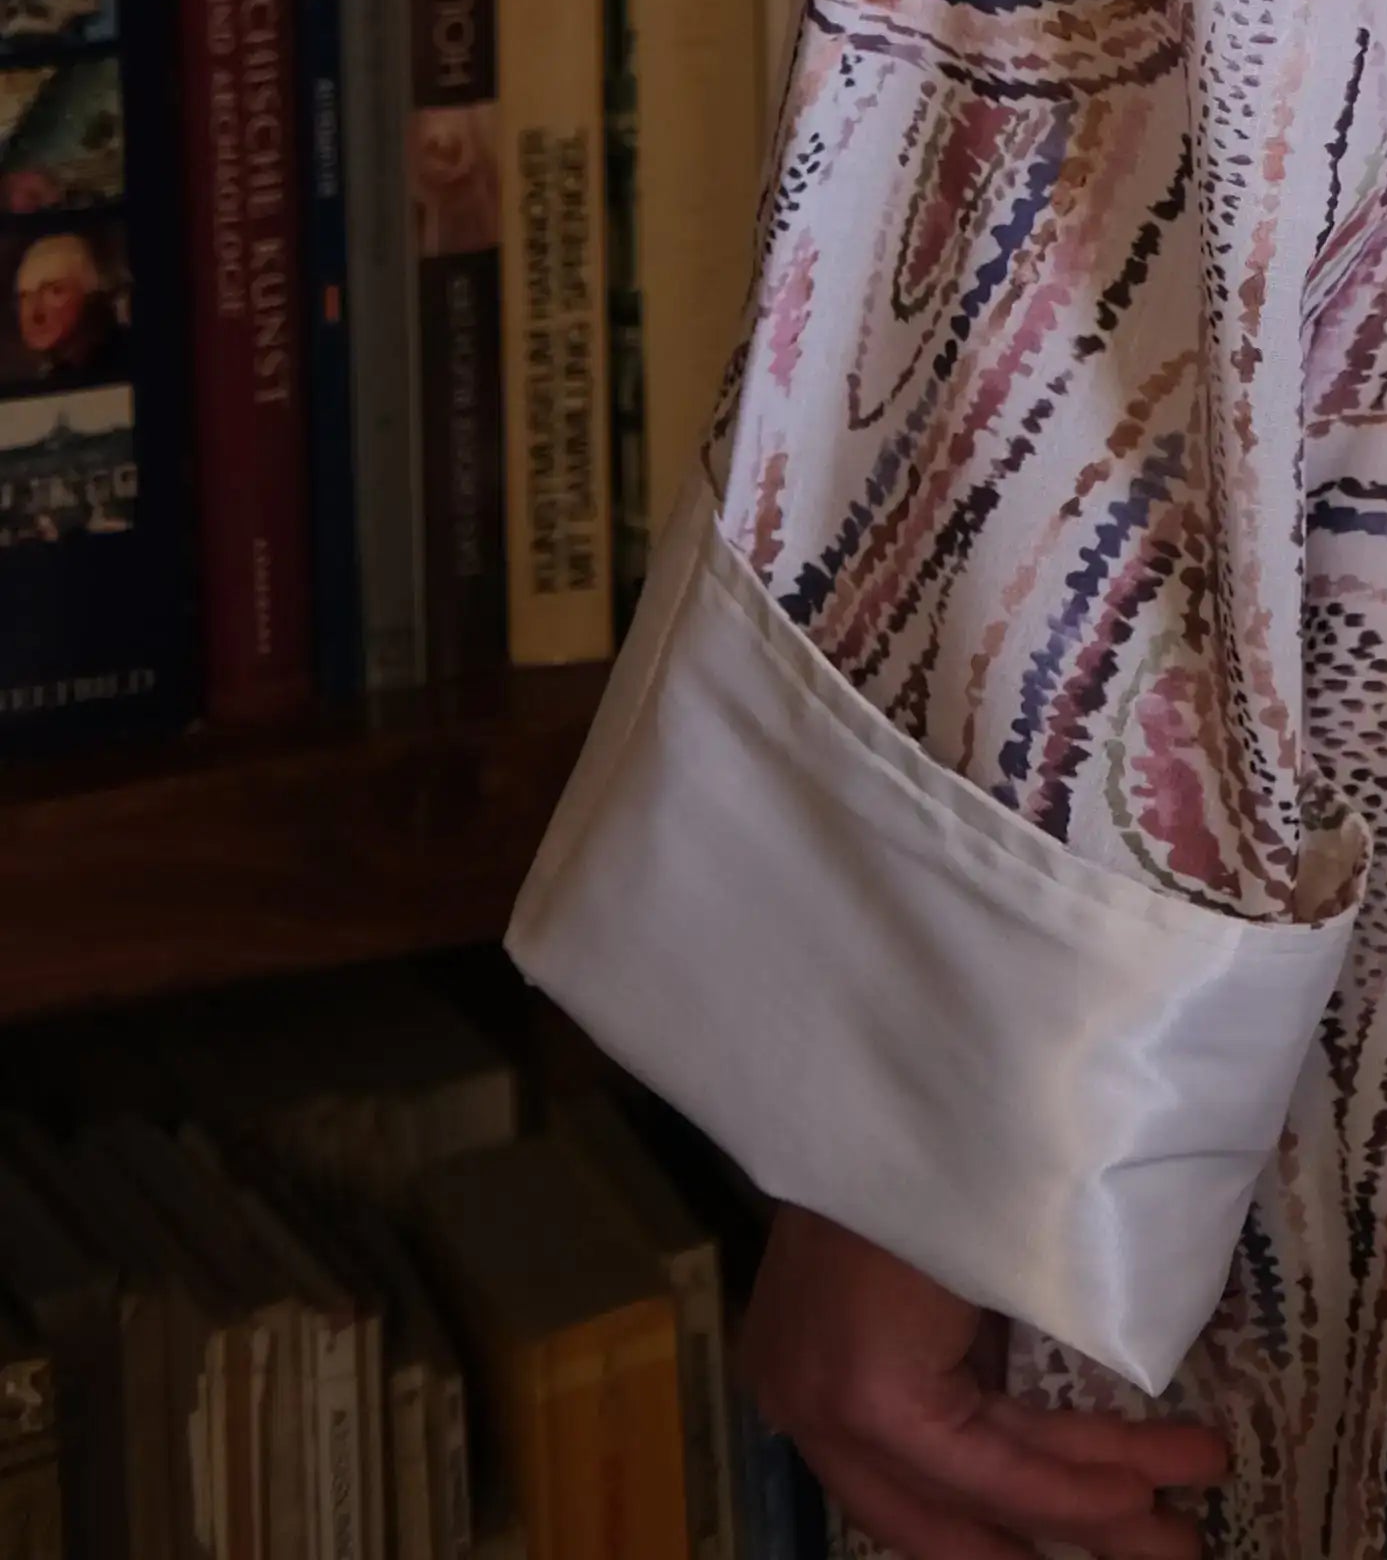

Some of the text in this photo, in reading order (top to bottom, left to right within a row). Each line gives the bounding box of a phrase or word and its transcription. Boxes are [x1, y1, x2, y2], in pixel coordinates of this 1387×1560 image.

[248, 237, 292, 408] KUNST
[518, 130, 557, 596] KUNSTMUSEUM HANNOVER
[554, 129, 597, 591] MIT SAMMLUNG SPRENGEL
